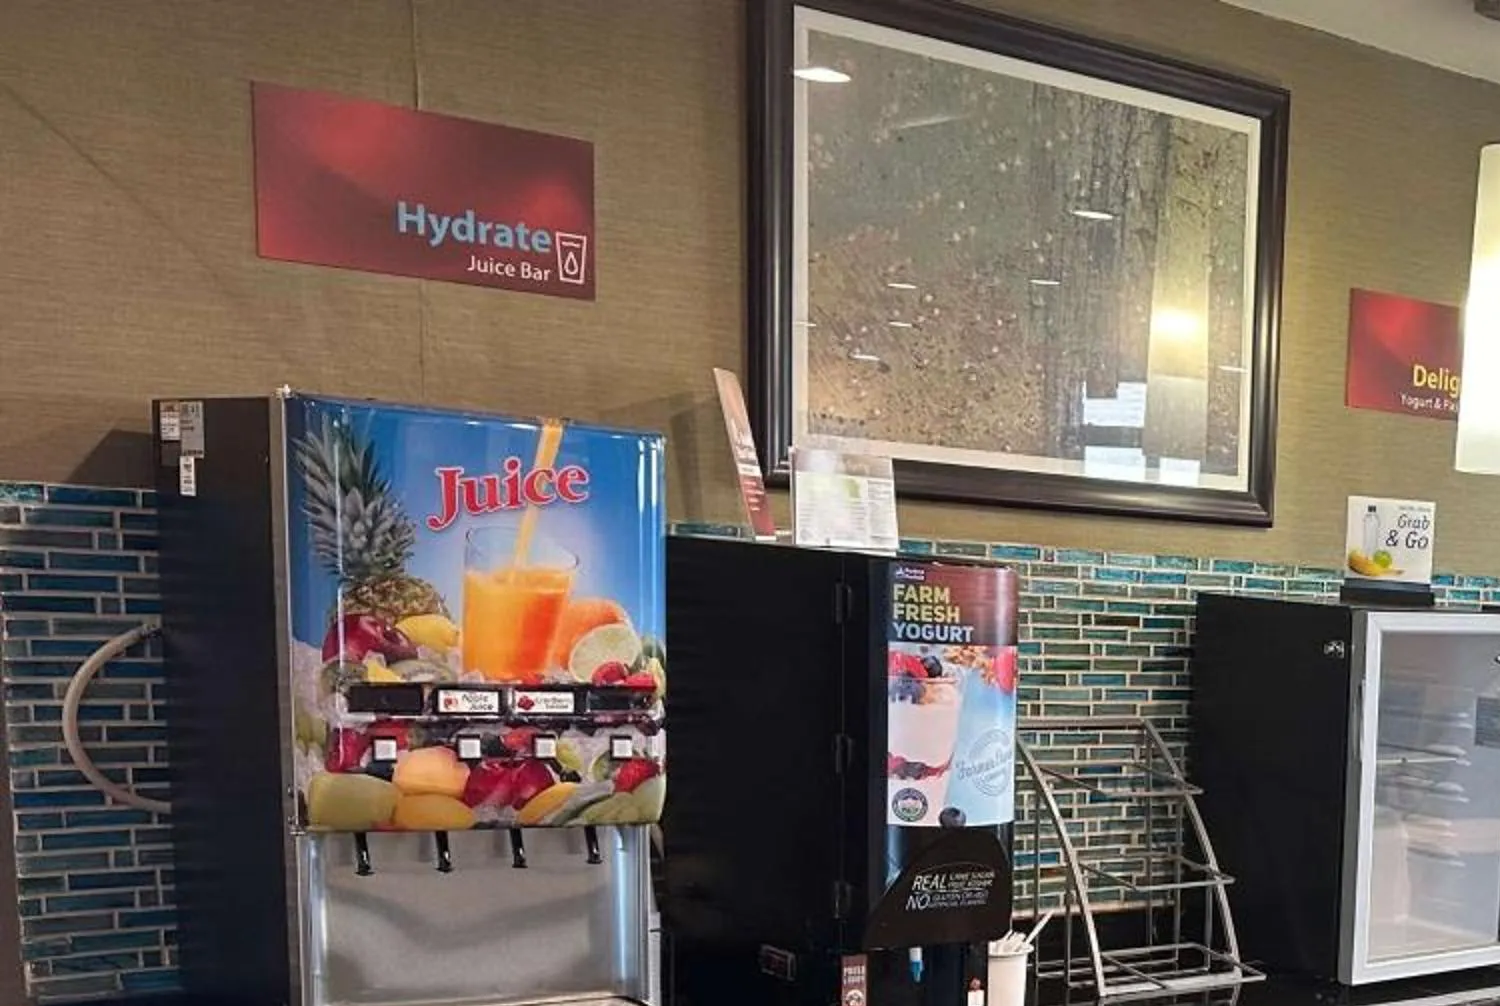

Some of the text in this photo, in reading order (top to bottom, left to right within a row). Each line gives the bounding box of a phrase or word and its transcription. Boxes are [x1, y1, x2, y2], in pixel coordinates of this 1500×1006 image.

[397, 201, 552, 253] Hydrate
[467, 255, 552, 281] Juice Bar
[1413, 364, 1461, 399] Delig
[426, 456, 590, 531] Juice
[1397, 513, 1430, 530] Grab
[1386, 529, 1429, 549] & Go
[893, 583, 951, 604] FARM
[893, 603, 960, 623] FRESH
[892, 621, 975, 643] YOGURT
[911, 873, 948, 891] REAL
[905, 893, 931, 911] NO
